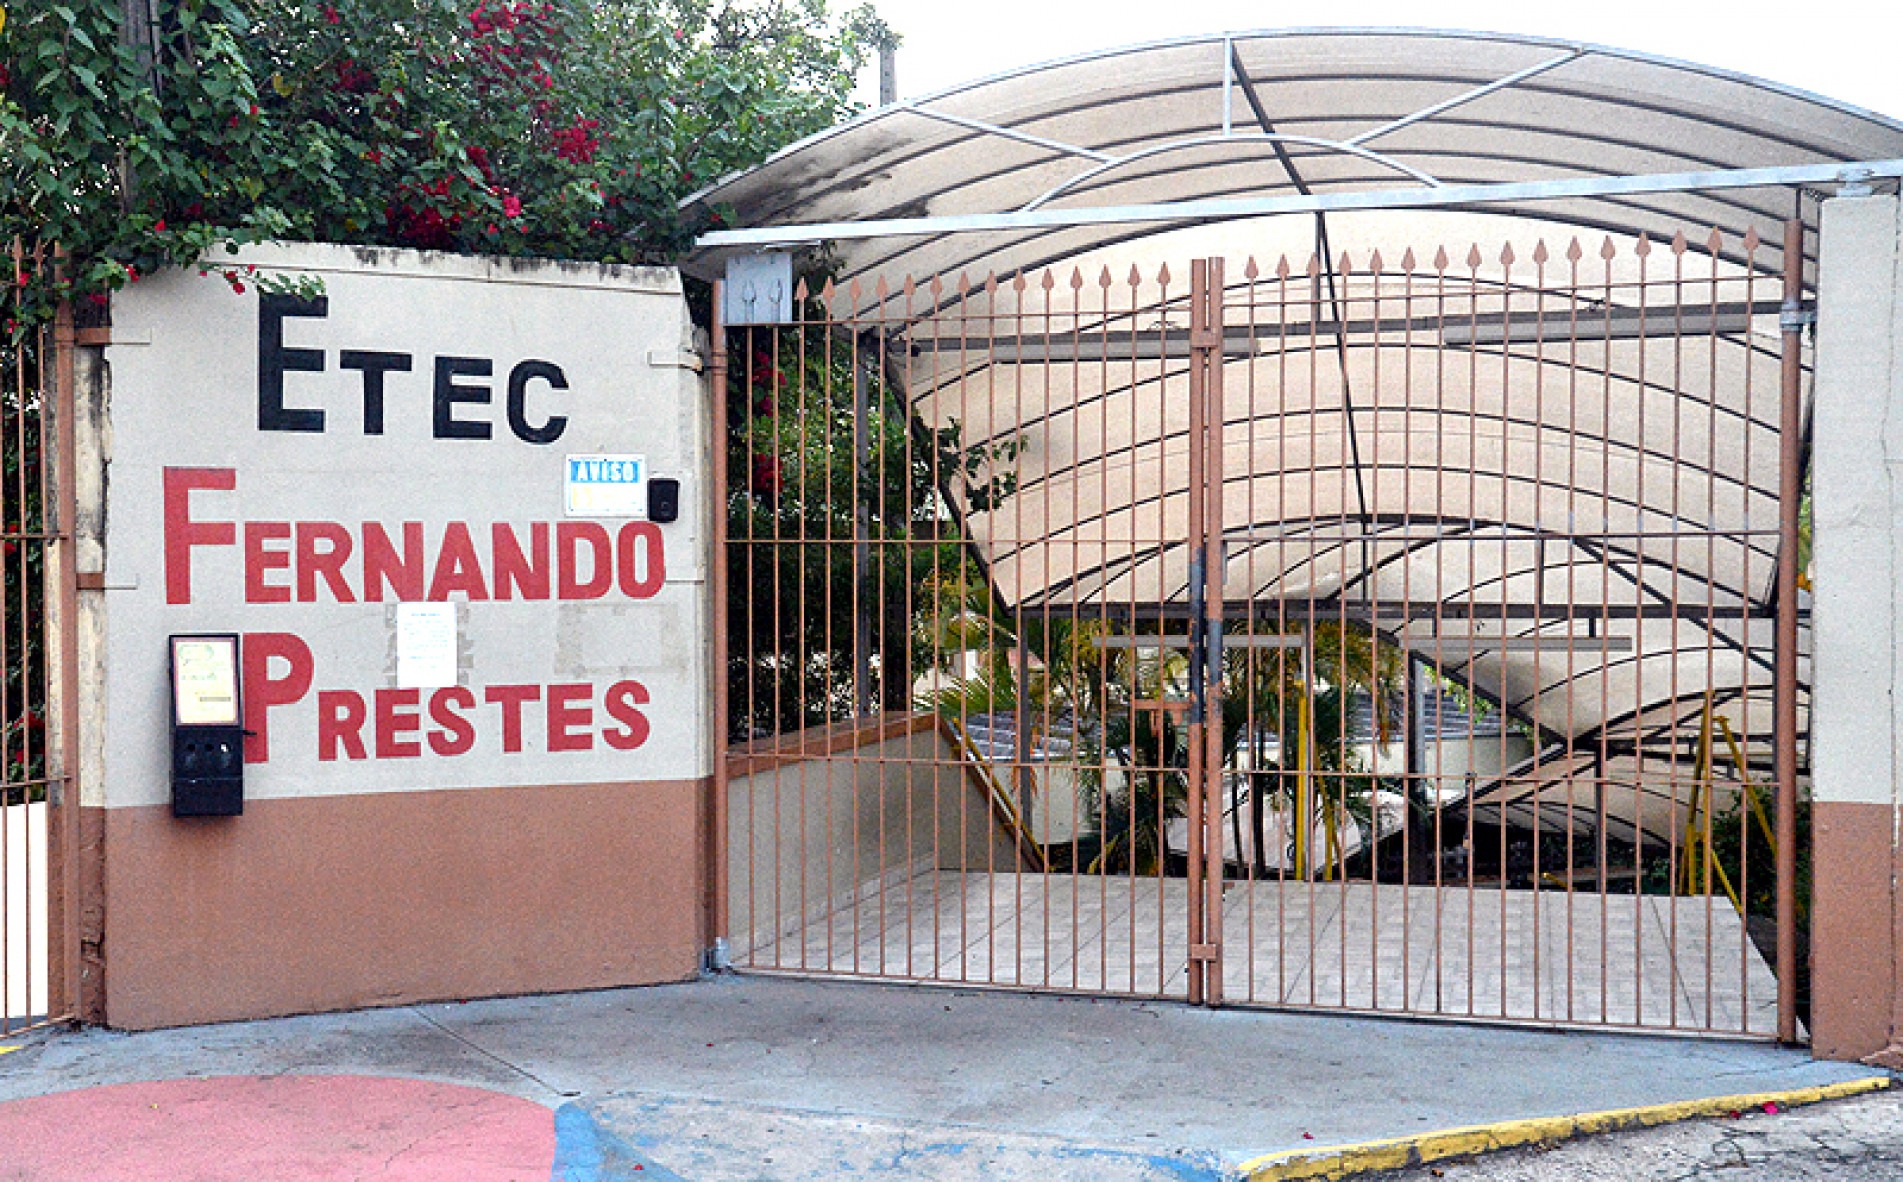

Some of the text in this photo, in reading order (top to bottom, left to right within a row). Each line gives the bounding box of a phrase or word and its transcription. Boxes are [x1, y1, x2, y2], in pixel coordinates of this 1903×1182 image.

[258, 295, 569, 444] ETEC
[163, 466, 666, 604] FERNANDO
[576, 462, 635, 481] AVISO
[242, 632, 651, 764] PRESTES
